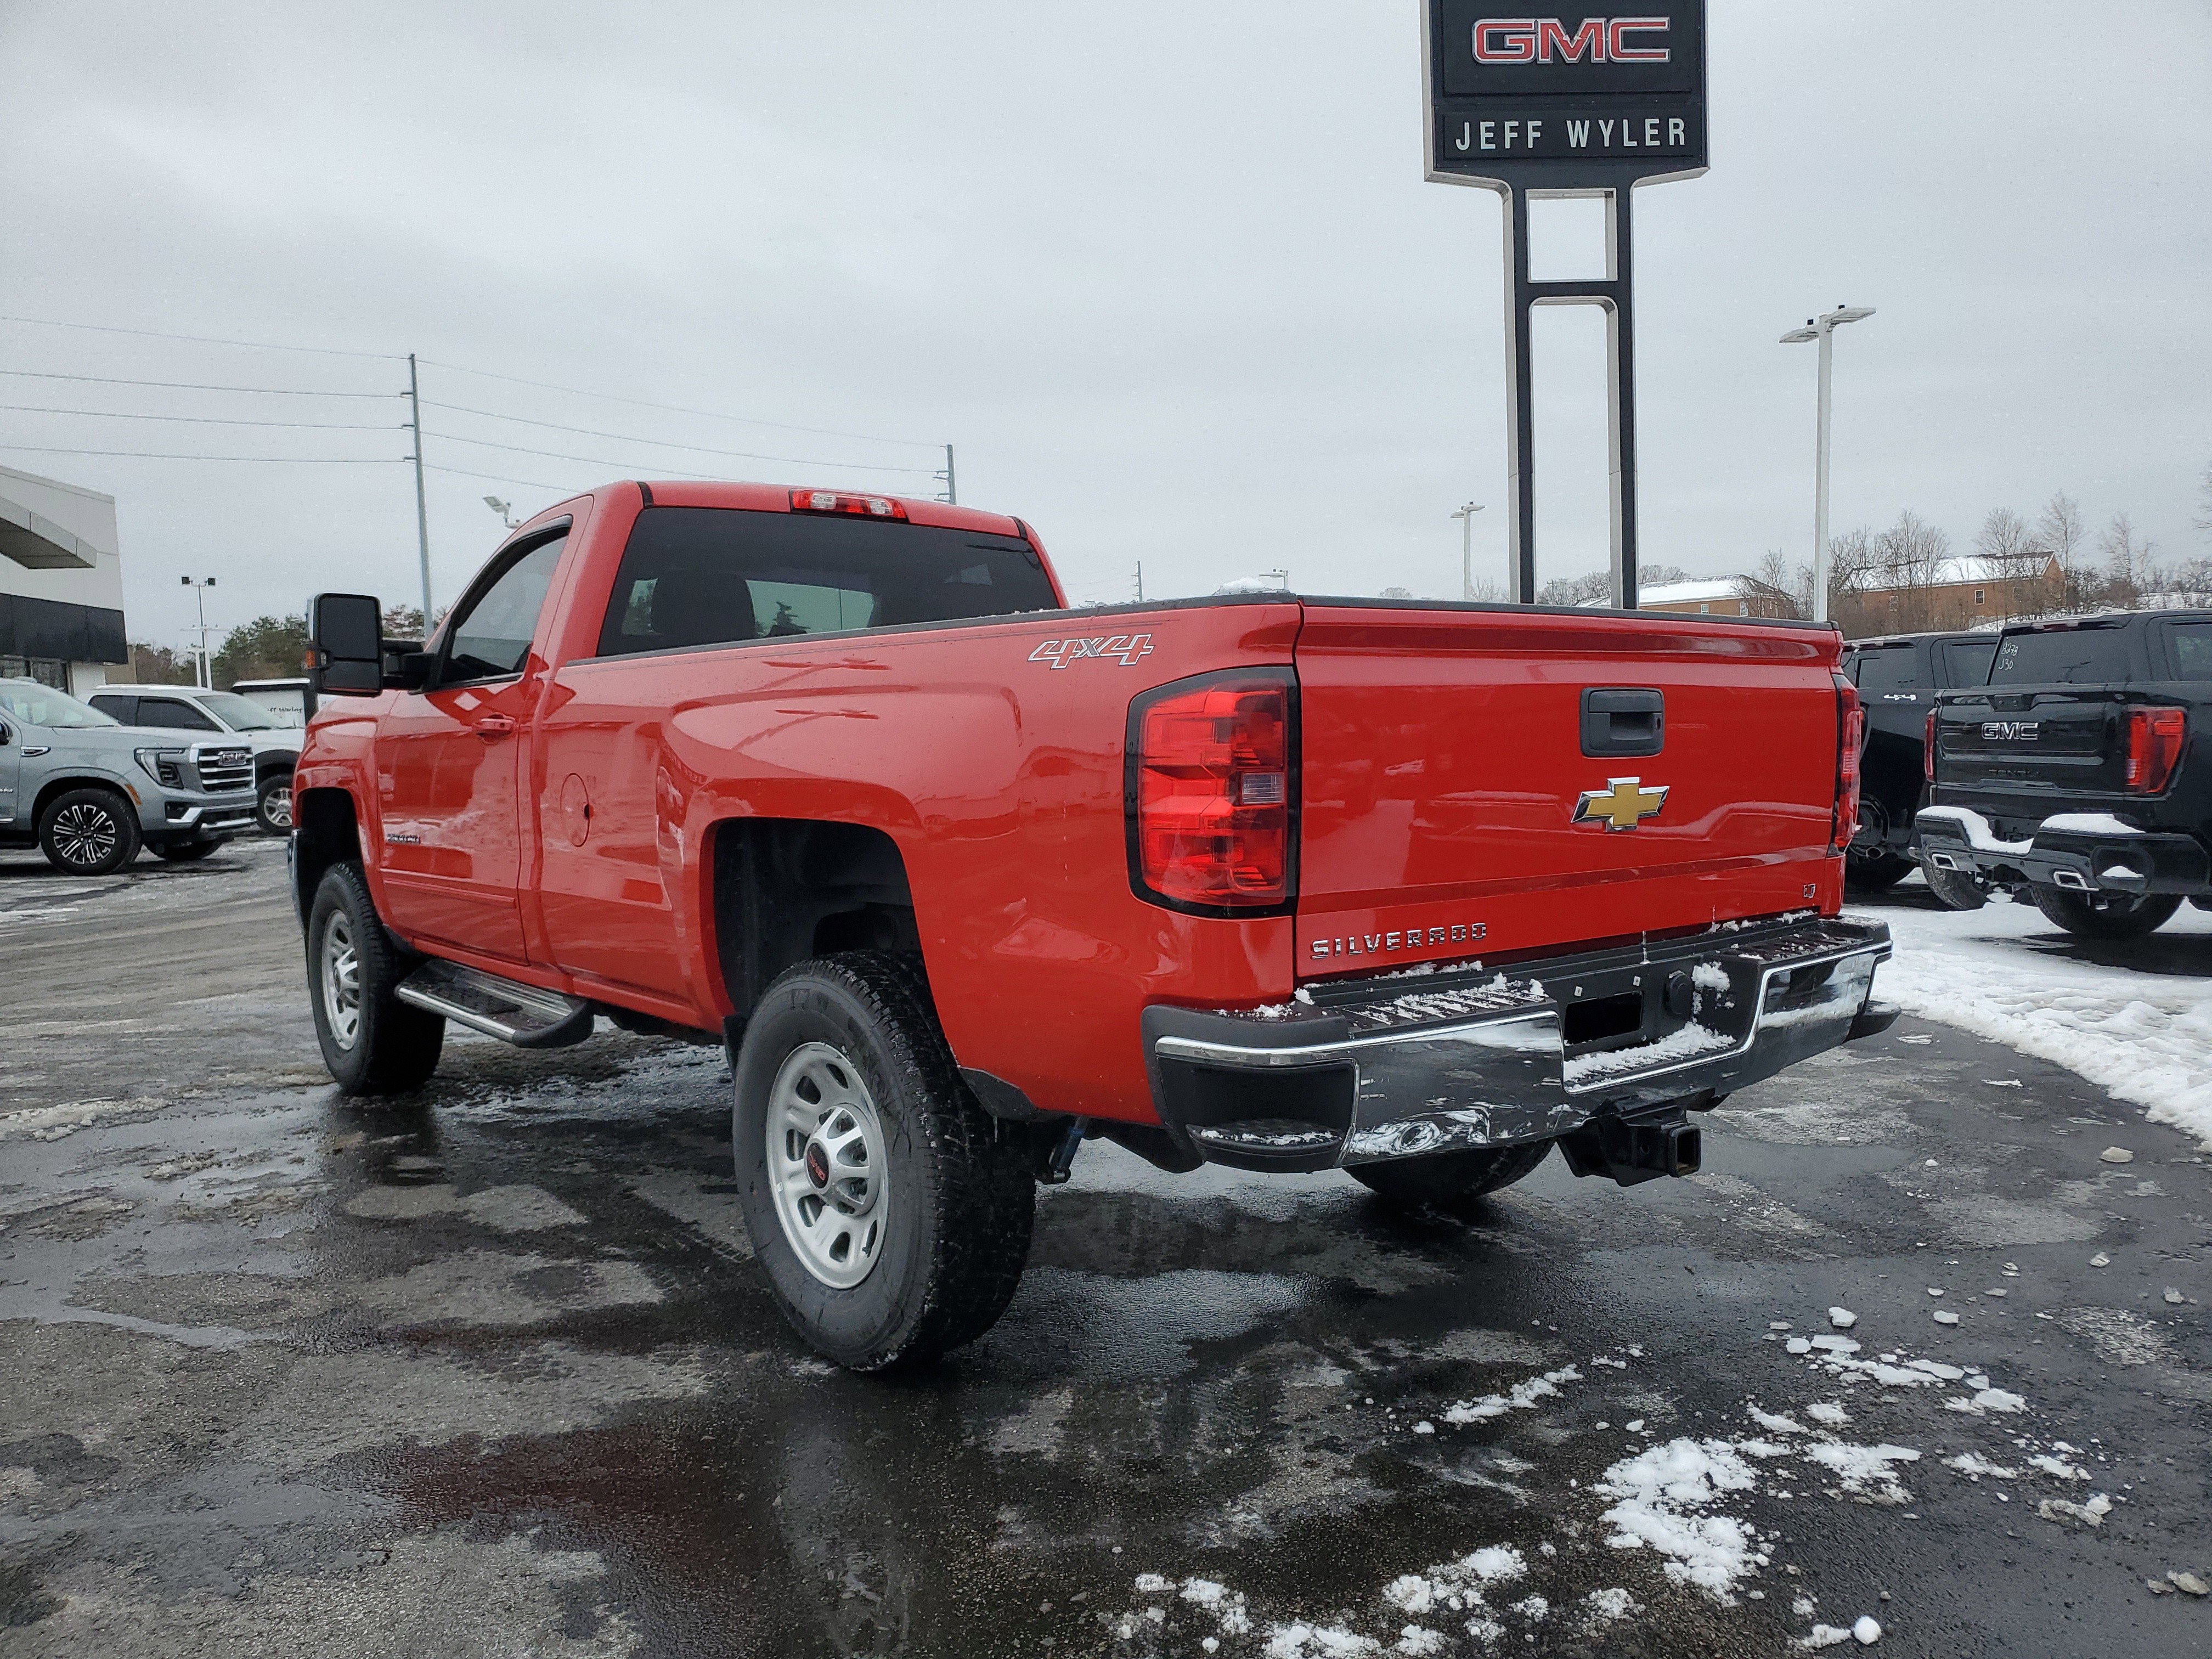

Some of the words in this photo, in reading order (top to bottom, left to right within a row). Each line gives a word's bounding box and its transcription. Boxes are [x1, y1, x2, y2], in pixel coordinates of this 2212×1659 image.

[1472, 17, 1671, 64] GMC
[1455, 120, 1542, 150] JEFF
[1566, 118, 1685, 148] WYLER
[1982, 721, 2039, 740] GMC
[1311, 922, 1487, 960] SILVERADO
